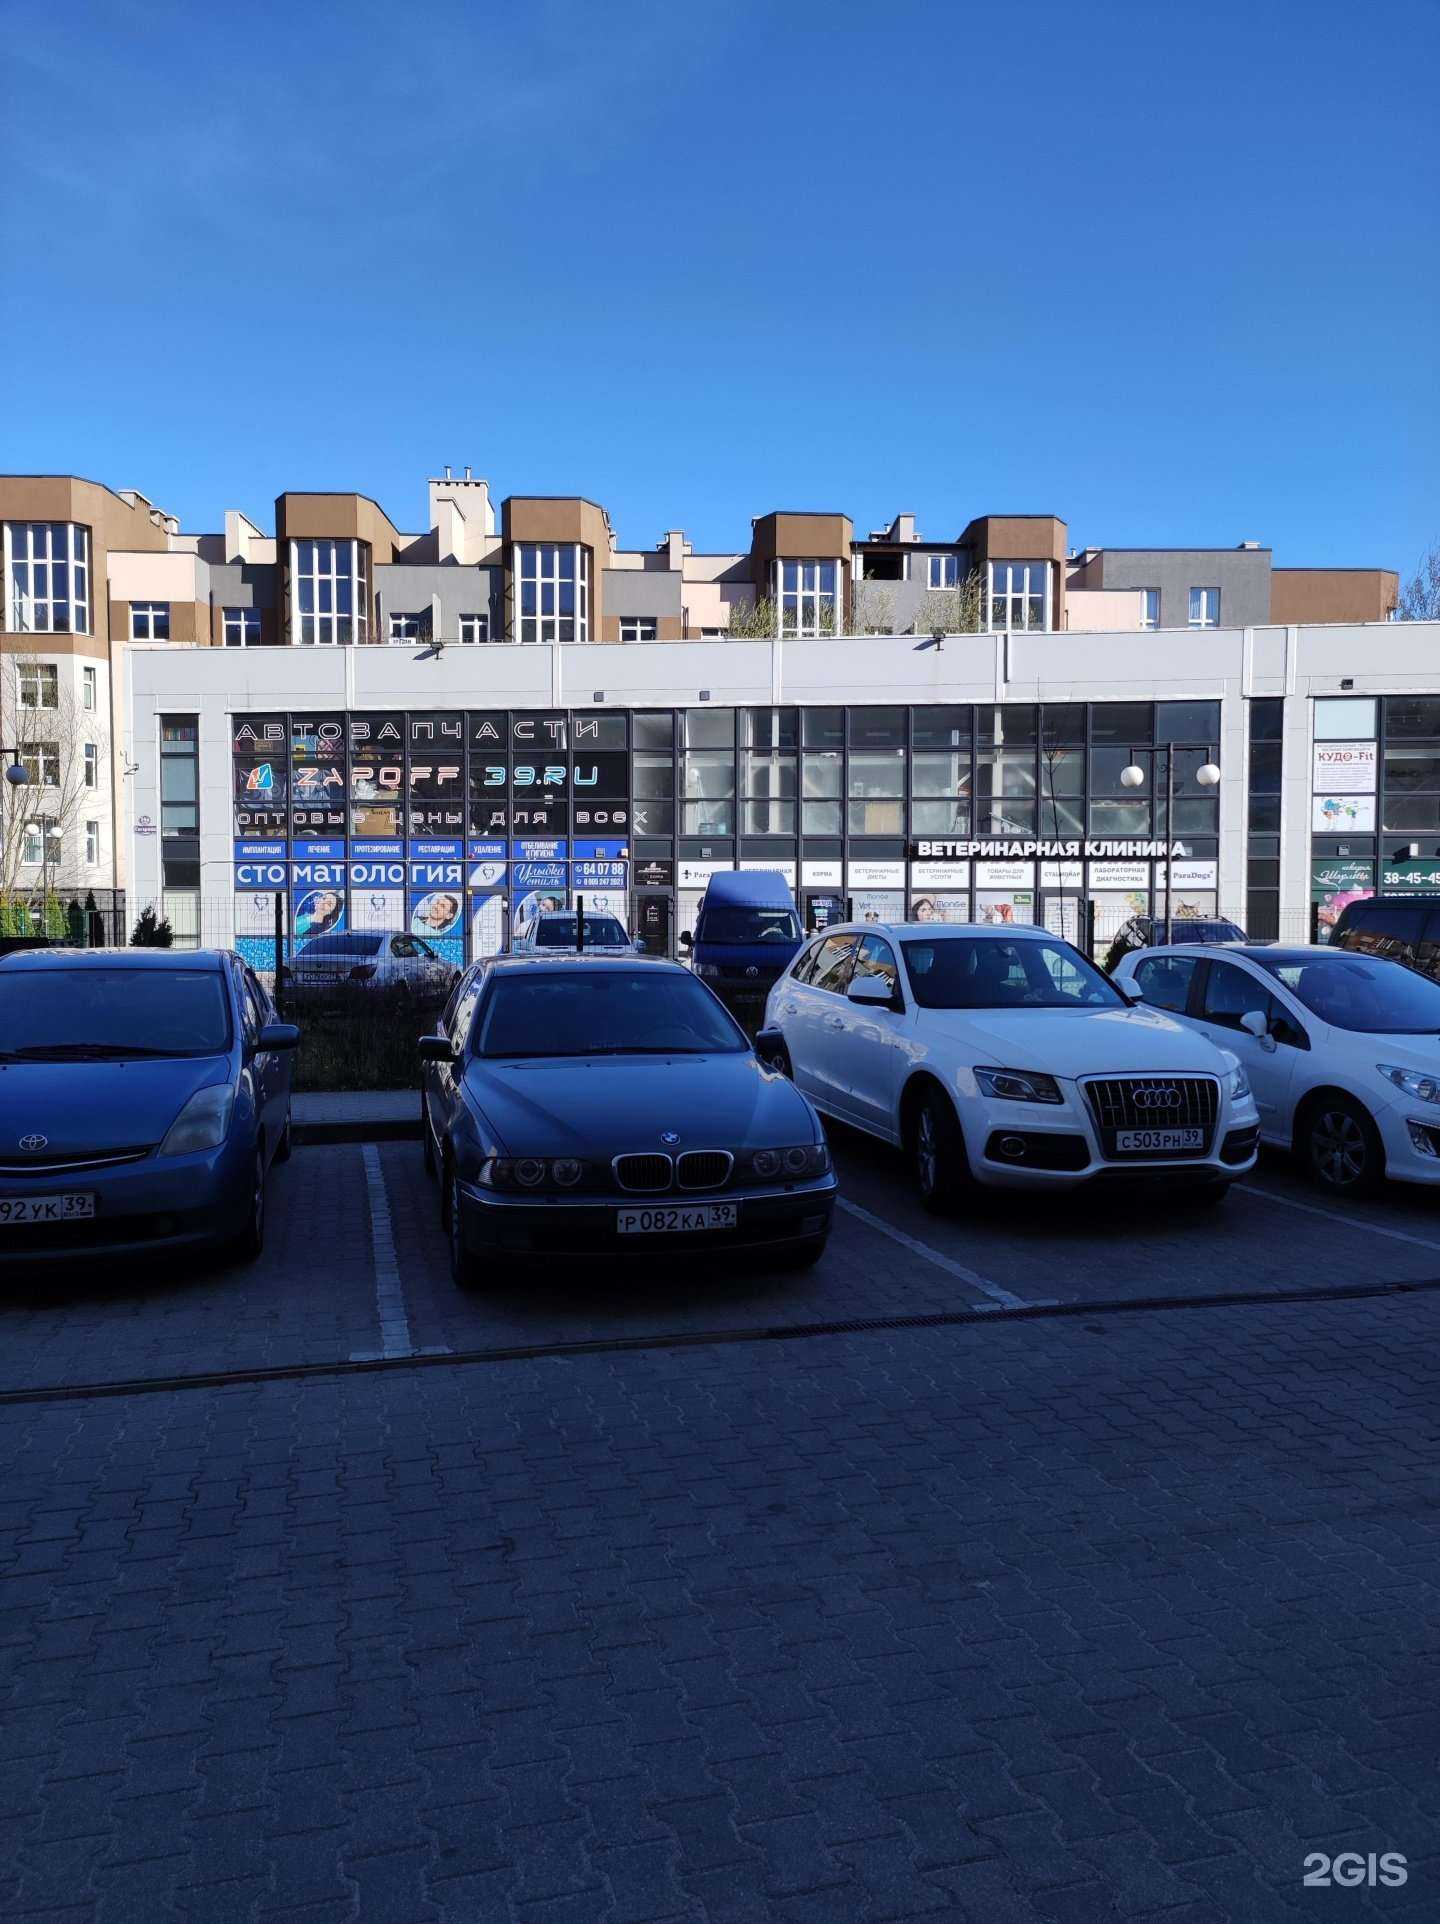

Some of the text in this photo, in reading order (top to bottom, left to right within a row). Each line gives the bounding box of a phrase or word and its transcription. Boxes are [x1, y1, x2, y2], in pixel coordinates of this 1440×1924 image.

[235, 721, 598, 741] АВТОЗАПЧАСТИ
[297, 766, 598, 786] ZAPOFF 39.RU
[354, 845, 400, 854] ПРОТЕЗИРОВАНИЕ
[417, 845, 456, 854] РЕСТАВРАЦИЯ
[473, 845, 502, 854] УДАЛЕНИЕ
[520, 841, 559, 849] ОТБЕЛИВАНИЕ
[918, 841, 1186, 857] ВЕТЕРИНАРНАЯ КЛИНИКА
[242, 846, 282, 855] ИМПЛАНТАЦИЯ
[307, 846, 331, 854] ЛЕЧЕНИЕ
[530, 849, 554, 857] ГИГИЕНА
[597, 862, 610, 875] 07
[611, 862, 625, 875] 88
[514, 863, 565, 884] Улыбка
[1173, 872, 1211, 880] ParaDogs
